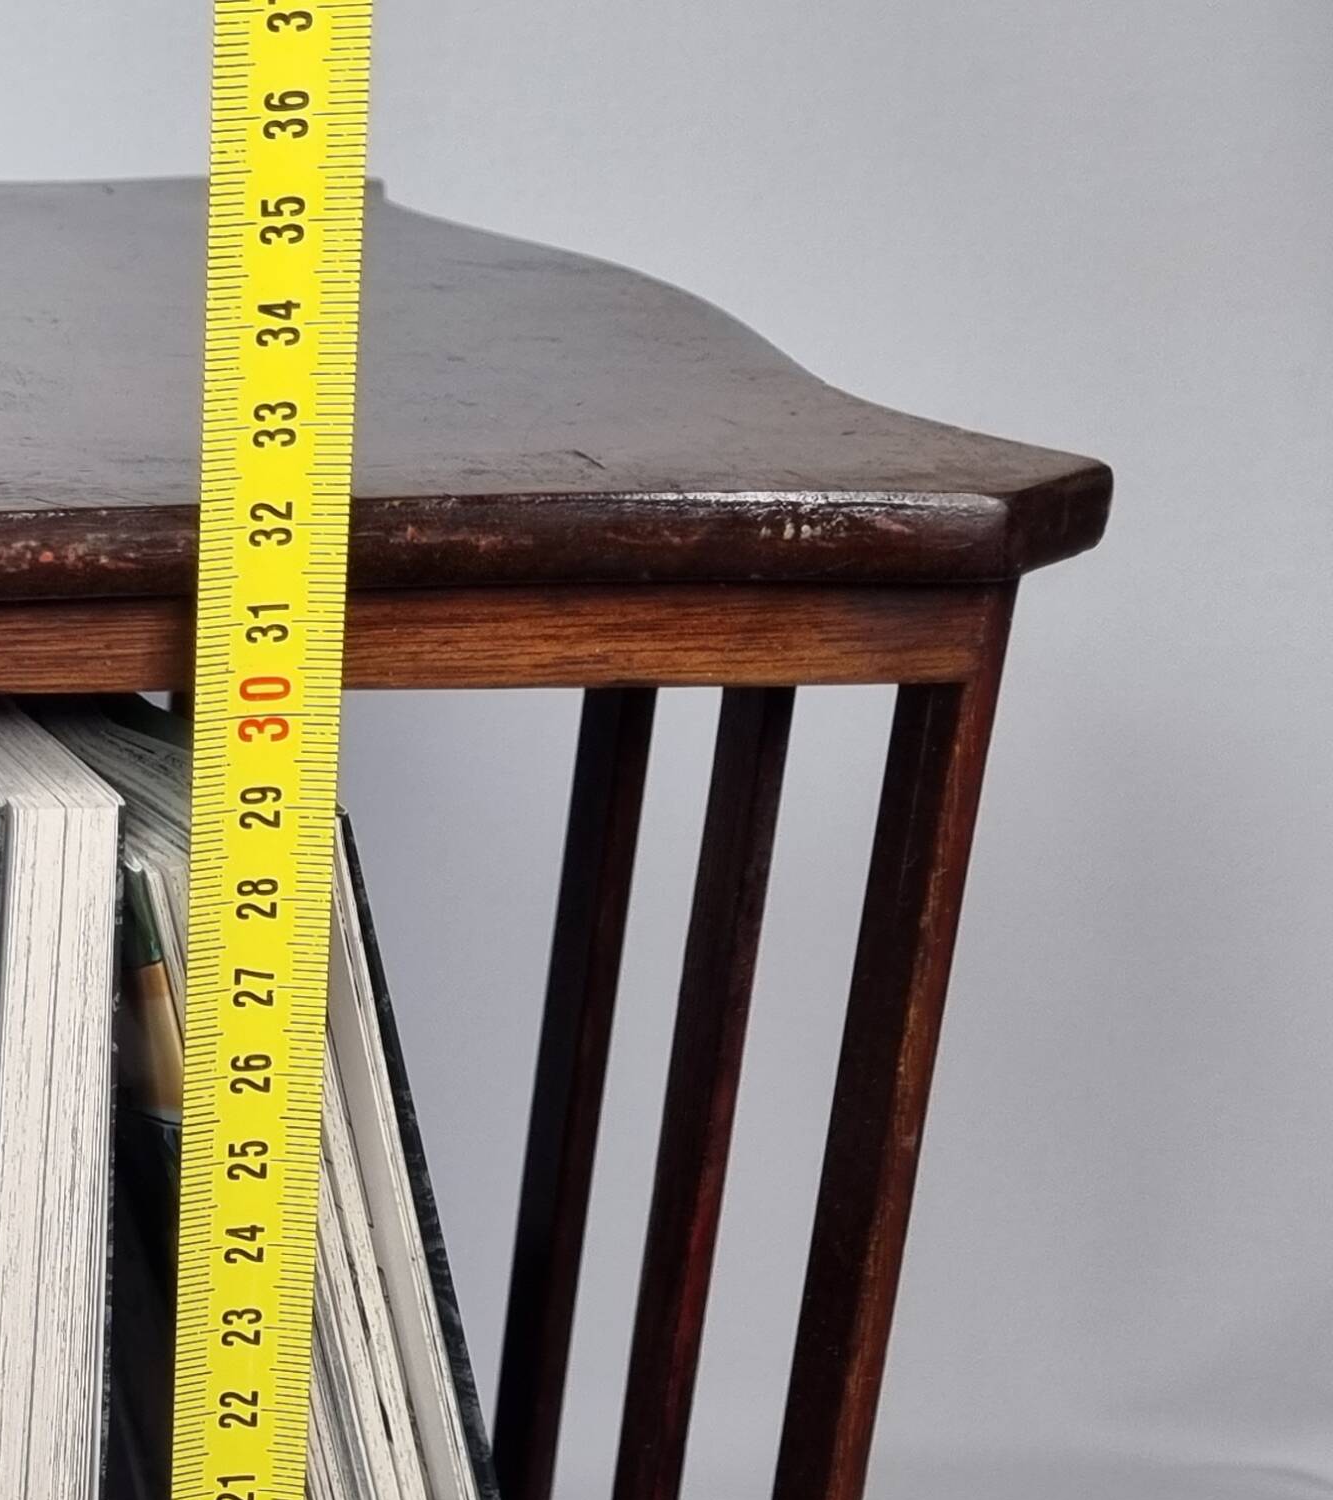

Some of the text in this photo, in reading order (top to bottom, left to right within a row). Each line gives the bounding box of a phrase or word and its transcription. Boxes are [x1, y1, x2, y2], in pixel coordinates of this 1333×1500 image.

[266, 0, 313, 33] 3
[263, 90, 309, 140] 36
[259, 196, 305, 245] 35
[256, 300, 301, 347] 34
[252, 401, 297, 448] 33
[249, 501, 293, 547] 32
[245, 604, 289, 643] 31
[236, 675, 292, 744] 30
[239, 786, 282, 829] 29
[235, 878, 278, 920] 28
[232, 968, 275, 1008] 27
[229, 1054, 272, 1094] 26
[226, 1140, 269, 1181] 25
[223, 1224, 265, 1264] 24
[221, 1308, 263, 1347] 23
[218, 1390, 259, 1429] 22
